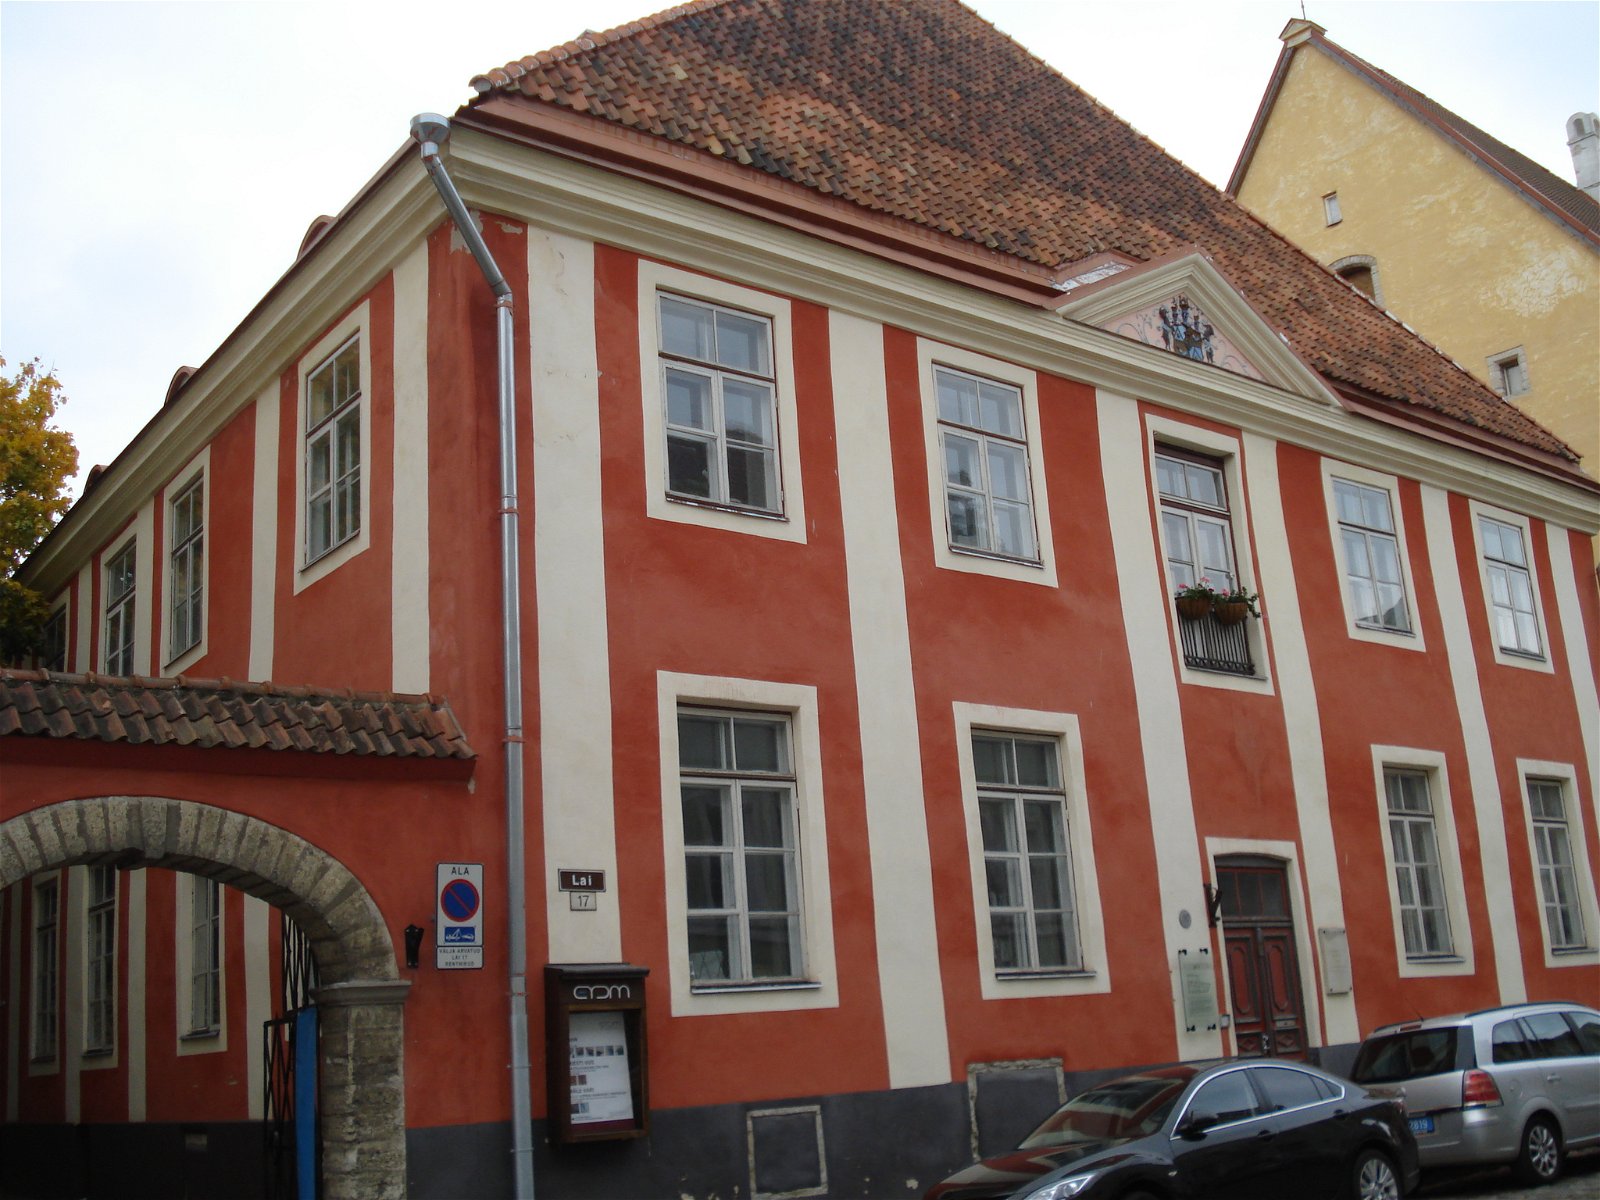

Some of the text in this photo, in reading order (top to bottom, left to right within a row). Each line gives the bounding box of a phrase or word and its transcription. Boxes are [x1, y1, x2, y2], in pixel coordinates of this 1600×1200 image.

[451, 867, 469, 875] ALA
[572, 874, 592, 886] Lai
[578, 895, 589, 907] 17
